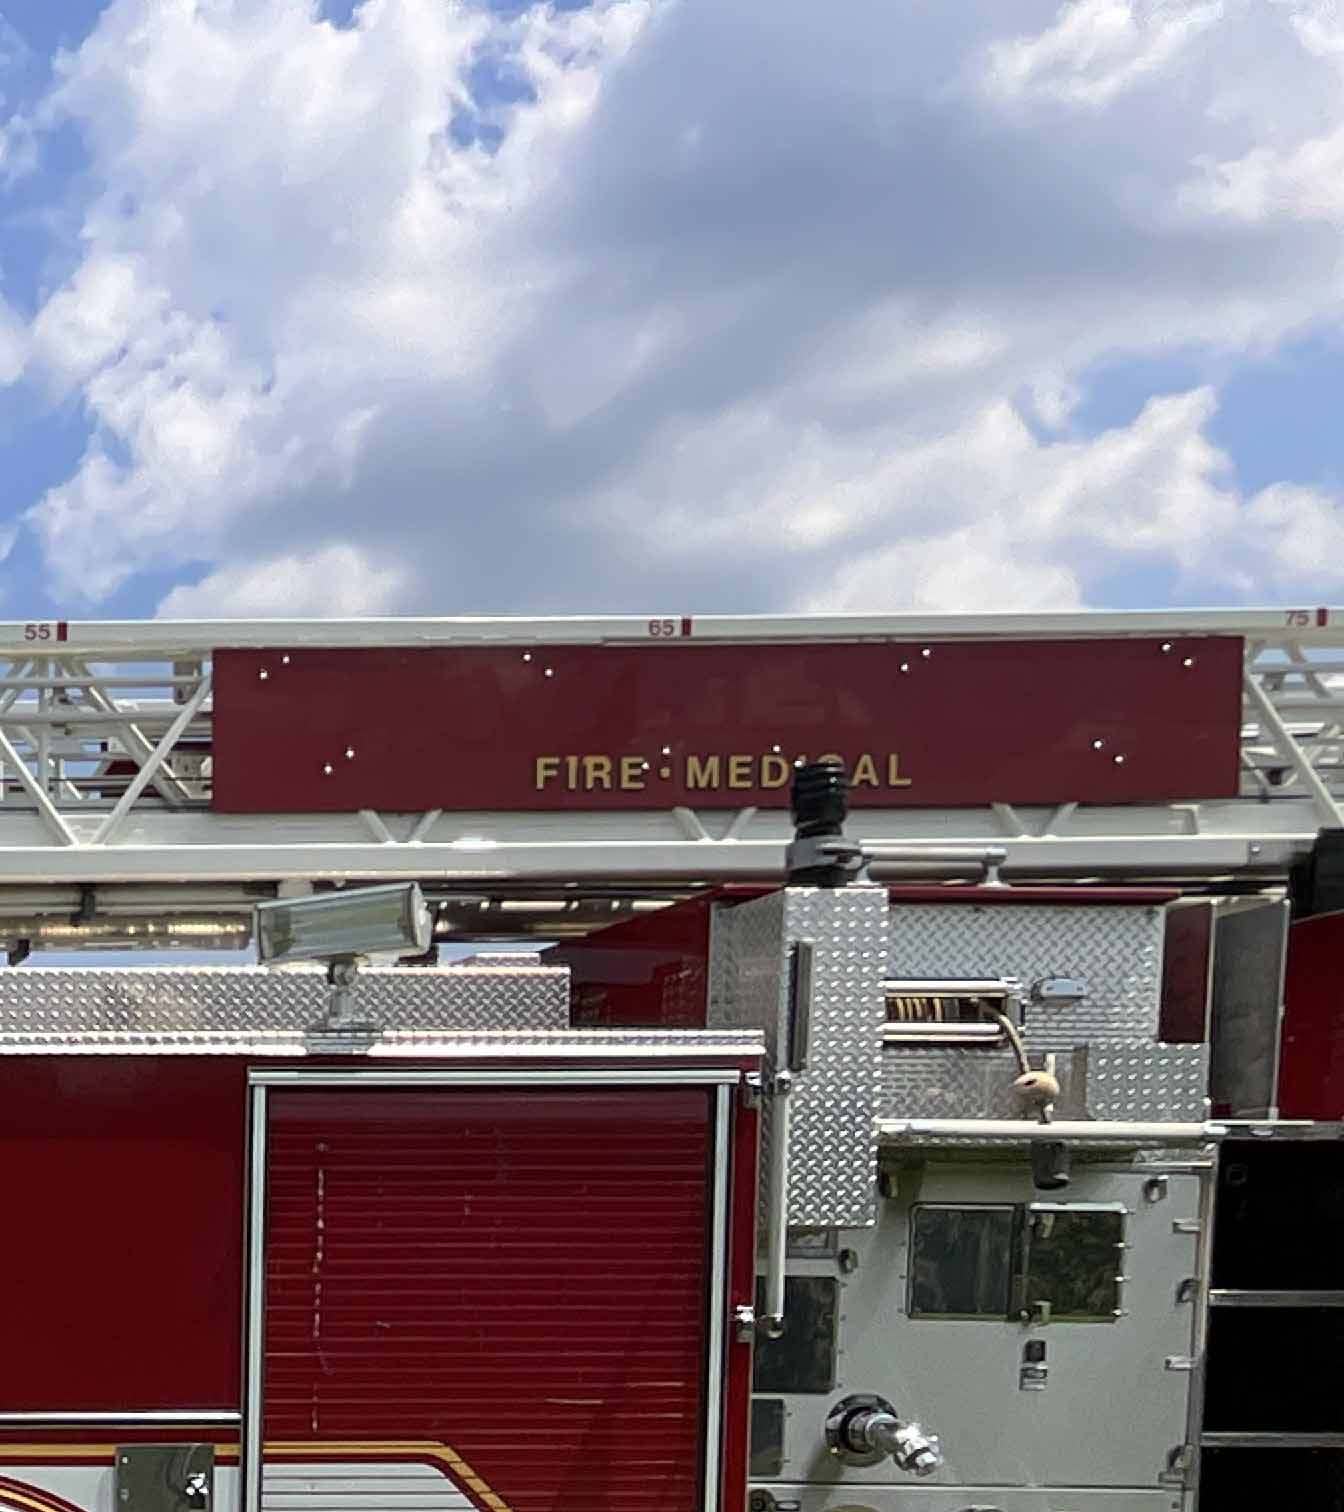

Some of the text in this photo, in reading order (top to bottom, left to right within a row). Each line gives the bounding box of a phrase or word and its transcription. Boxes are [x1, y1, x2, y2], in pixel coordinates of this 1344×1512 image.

[1285, 609, 1310, 626] 75
[23, 623, 50, 641] 55
[648, 619, 674, 637] 65
[535, 753, 913, 790] FIRE MEDAL
